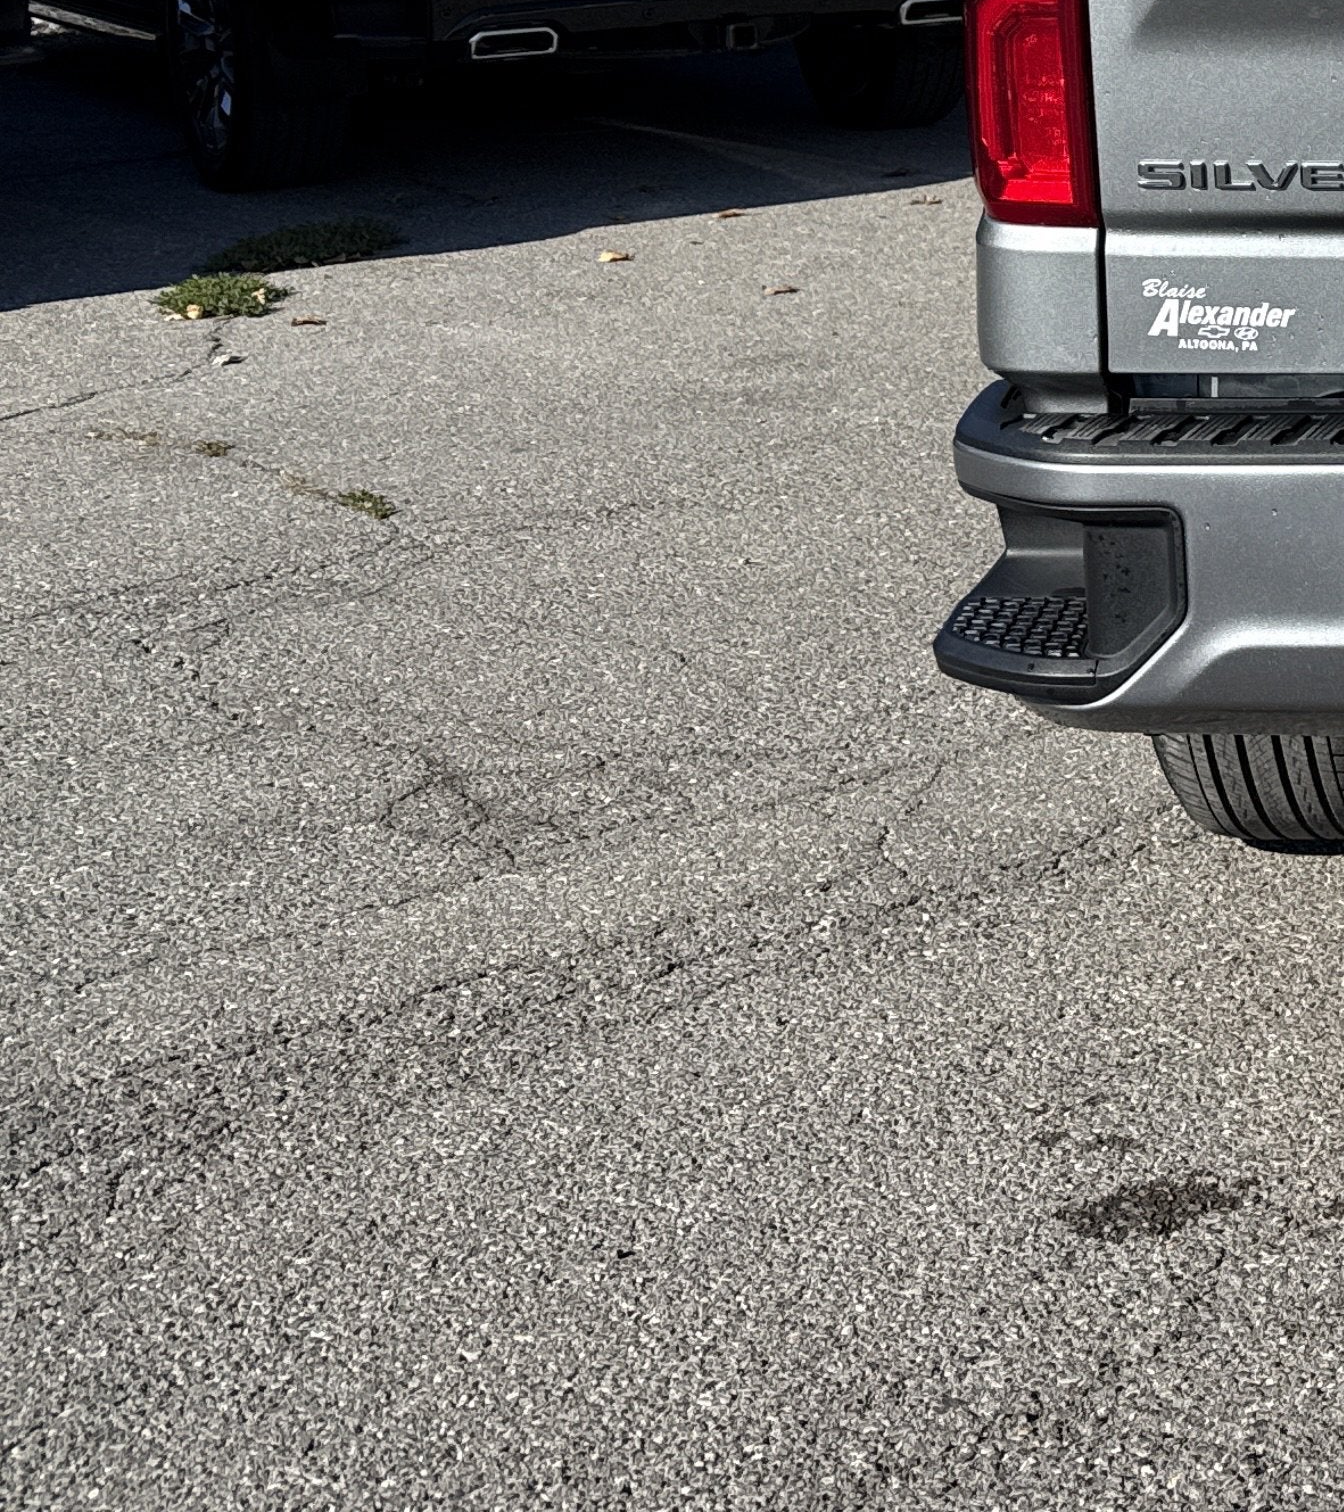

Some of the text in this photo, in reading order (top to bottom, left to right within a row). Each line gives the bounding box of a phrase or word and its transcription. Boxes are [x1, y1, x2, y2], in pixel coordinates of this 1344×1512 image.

[1142, 278, 1207, 299] Blaise
[1147, 299, 1297, 337] Alexander
[1178, 338, 1259, 353] ALTOONA, PA
